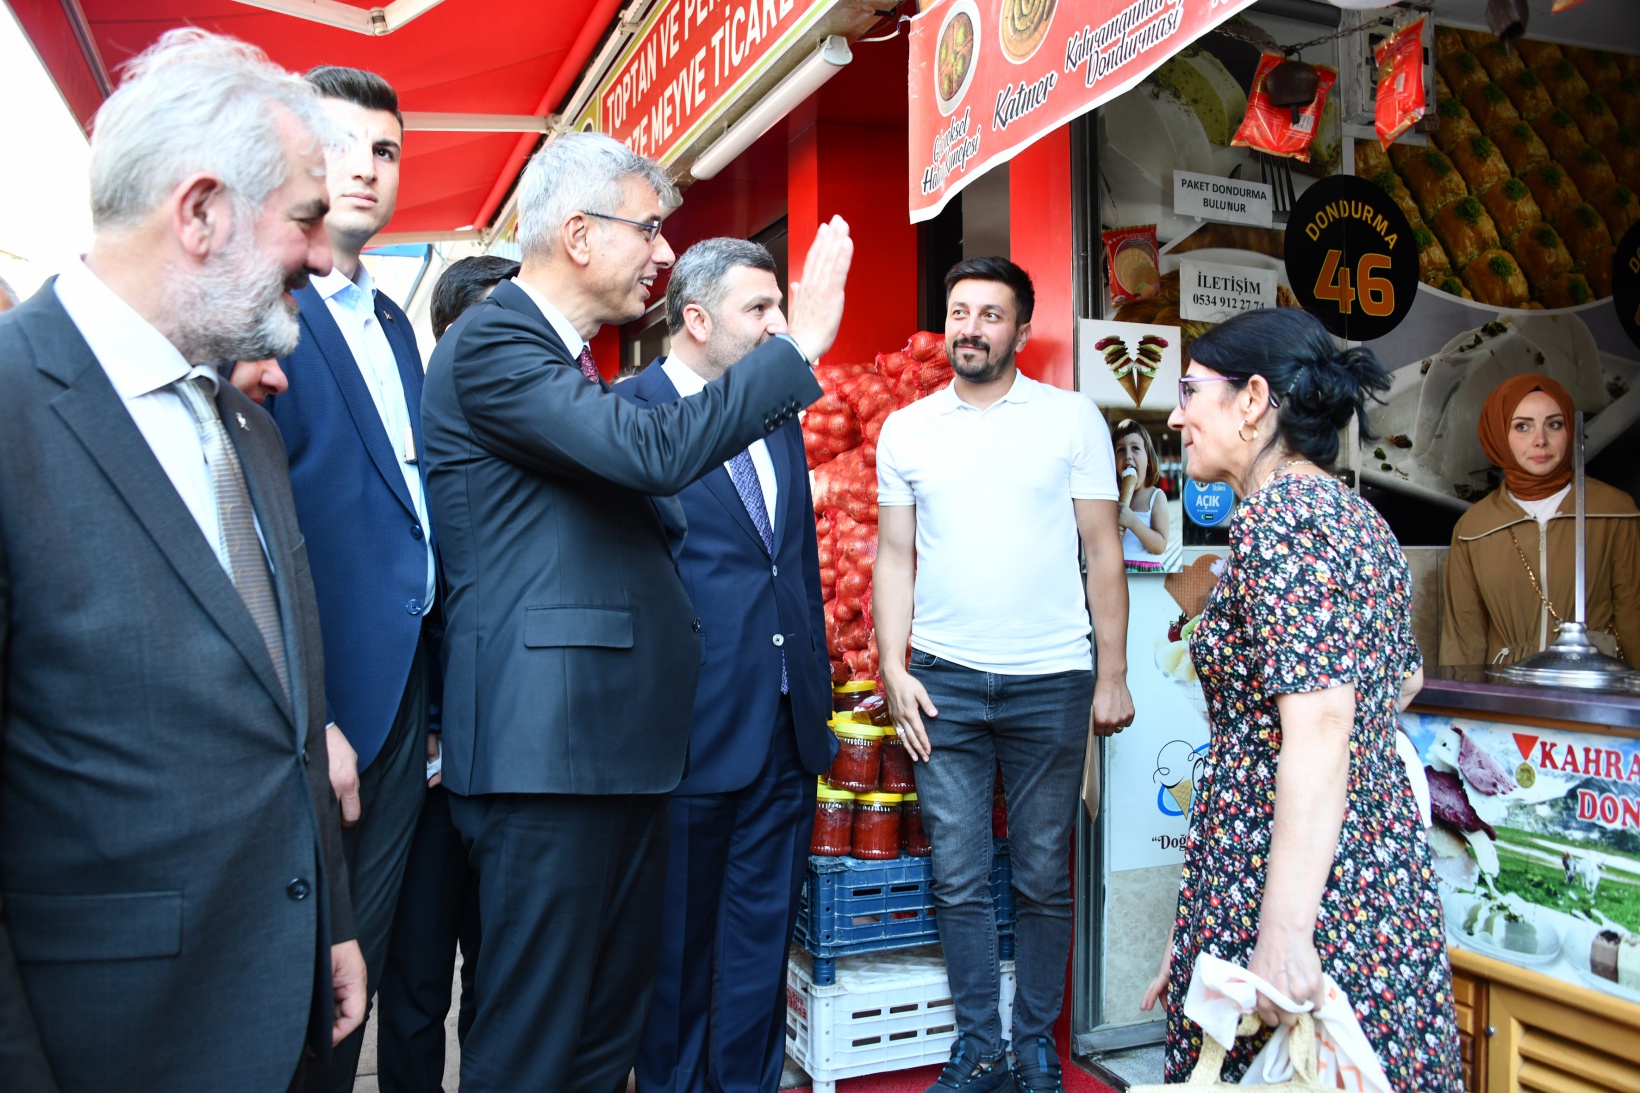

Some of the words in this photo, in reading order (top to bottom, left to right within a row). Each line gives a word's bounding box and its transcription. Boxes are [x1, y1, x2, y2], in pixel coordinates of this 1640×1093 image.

[606, 32, 657, 137] TOPTAN
[660, 1, 680, 68] VE
[684, 0, 721, 41] PE
[1088, 10, 1179, 86] Dondurması
[651, 45, 707, 154] MEYVE
[993, 73, 1057, 129] Katmer
[1181, 178, 1211, 192] PAKET
[1212, 183, 1267, 200] DONDURMA
[1203, 198, 1246, 213] BULUNUR
[1305, 200, 1398, 250] DONDURMA
[1193, 293, 1217, 307] 0534
[1220, 296, 1237, 309] 912
[1240, 299, 1251, 310] 27
[1197, 271, 1261, 295] İLETİŞİM
[1313, 249, 1395, 317] 46
[1195, 494, 1220, 510] AÇIK
[1539, 741, 1640, 782] KAHRA
[1578, 790, 1640, 829] DON
